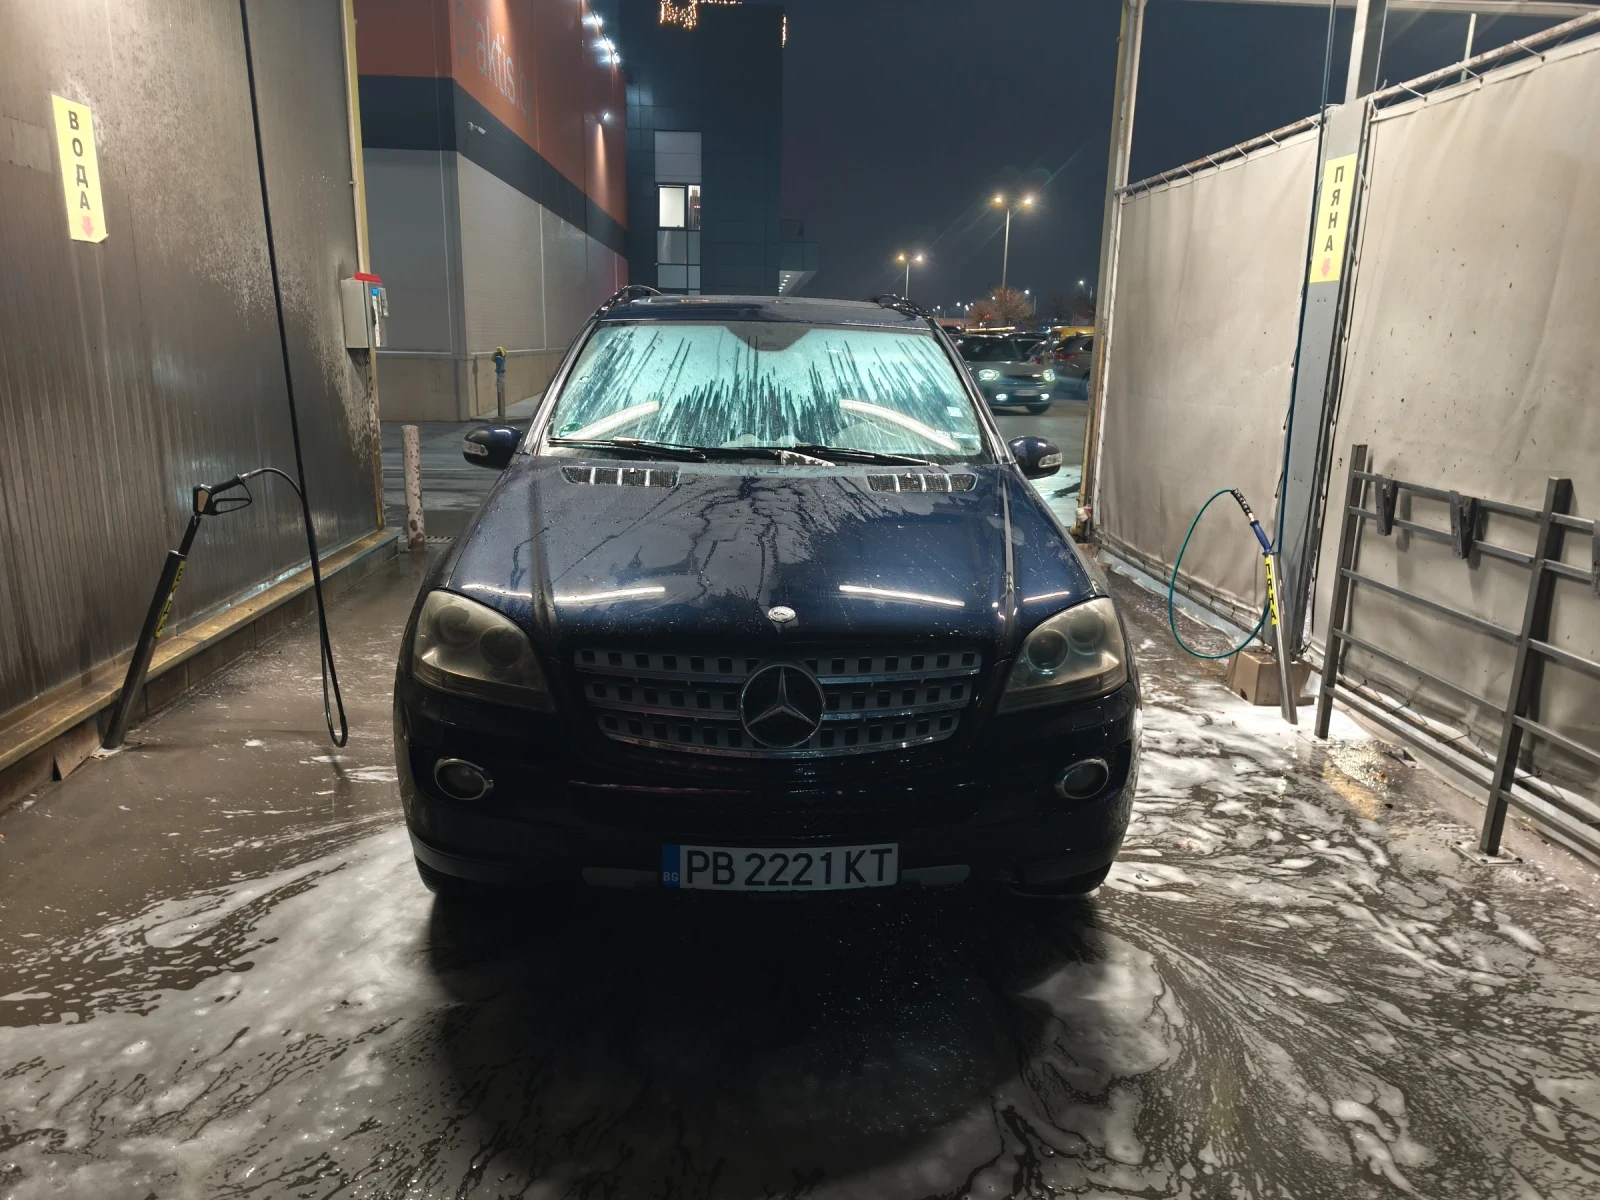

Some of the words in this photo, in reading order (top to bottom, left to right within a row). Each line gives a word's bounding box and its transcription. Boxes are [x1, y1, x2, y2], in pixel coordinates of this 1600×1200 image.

[68, 109, 91, 211] ВОДА
[1324, 165, 1345, 252] ПЯНА
[663, 871, 679, 882] BG
[687, 850, 735, 886] PB
[744, 851, 832, 886] 2221
[844, 848, 893, 883] KT
